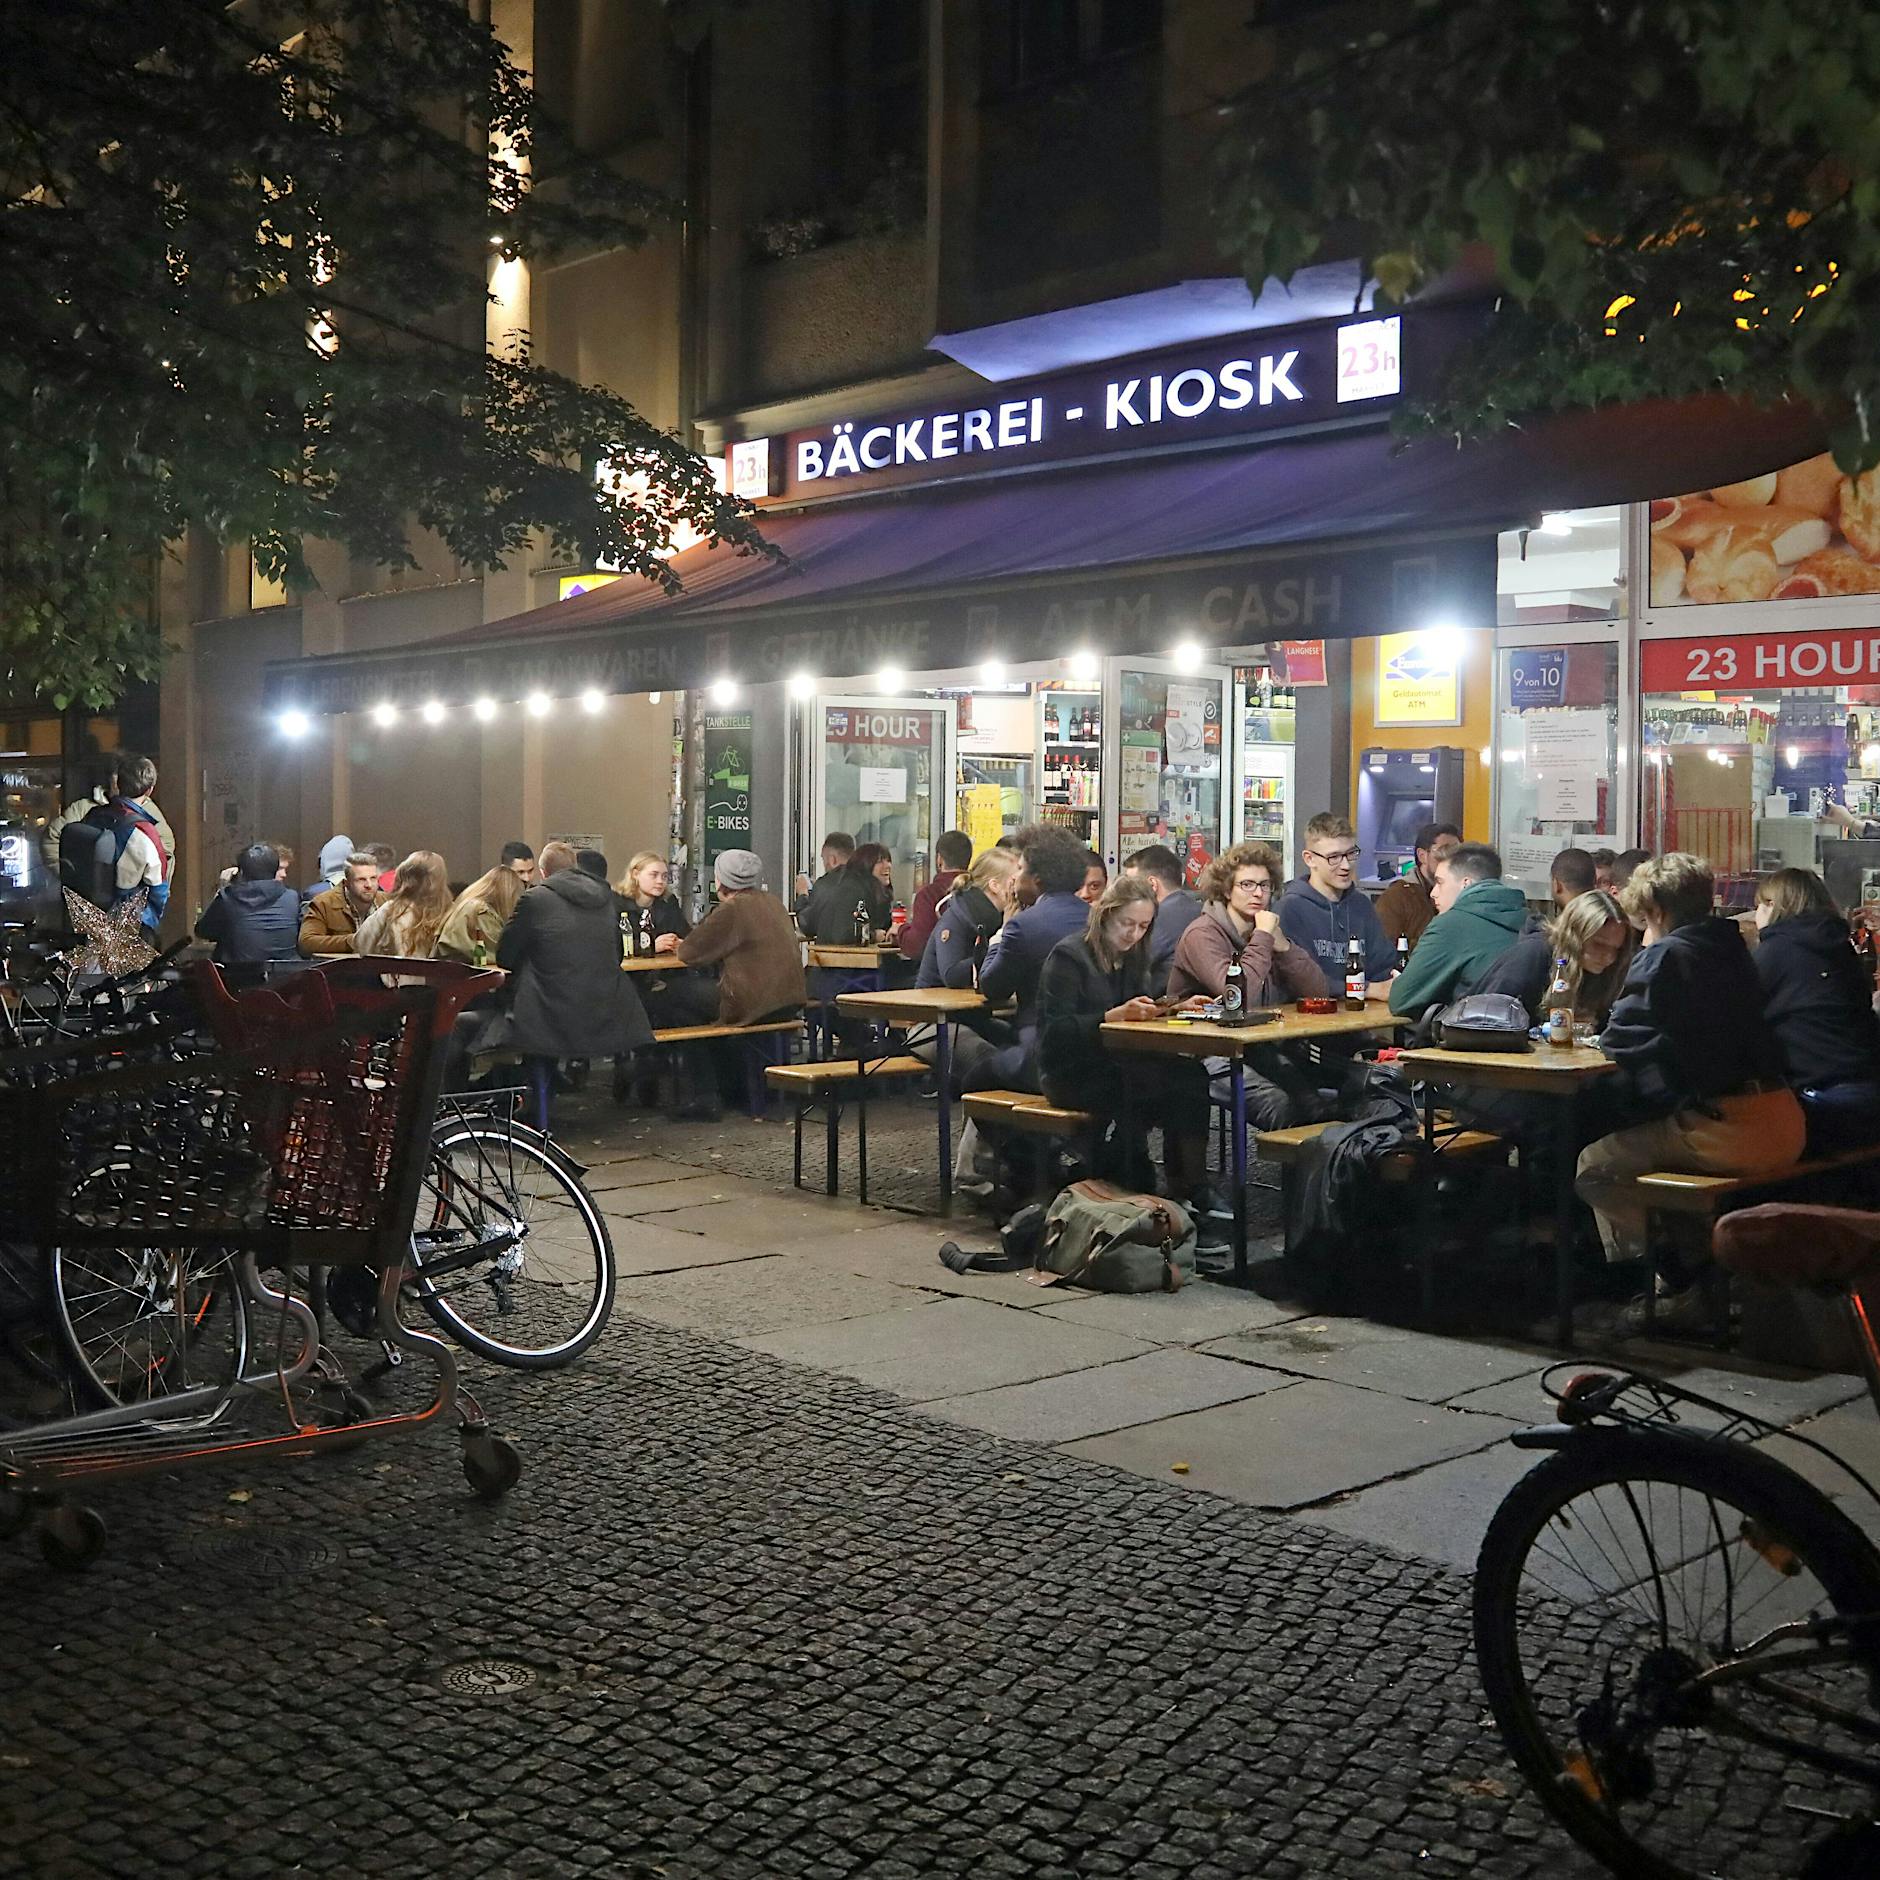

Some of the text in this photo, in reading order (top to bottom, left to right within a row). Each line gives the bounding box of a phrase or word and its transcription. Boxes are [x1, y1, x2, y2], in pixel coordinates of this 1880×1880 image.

[1342, 342, 1396, 378] 23h
[797, 349, 1304, 482] BÄCKEREI - KIOSK
[735, 456, 766, 484] 23h
[1034, 592, 1151, 650] ATM
[1200, 574, 1341, 634] CASH
[760, 614, 931, 671] GETRÄNKE
[1286, 646, 1320, 656] LANGNESE
[1513, 667, 1560, 687] 9 von 10
[1686, 647, 1738, 682] 23
[1392, 689, 1442, 698] Geldautomat
[1407, 700, 1426, 709] ATM
[705, 716, 751, 727] TANKSTELLE
[855, 714, 921, 739] HOUR
[707, 815, 750, 831] E-BIKES
